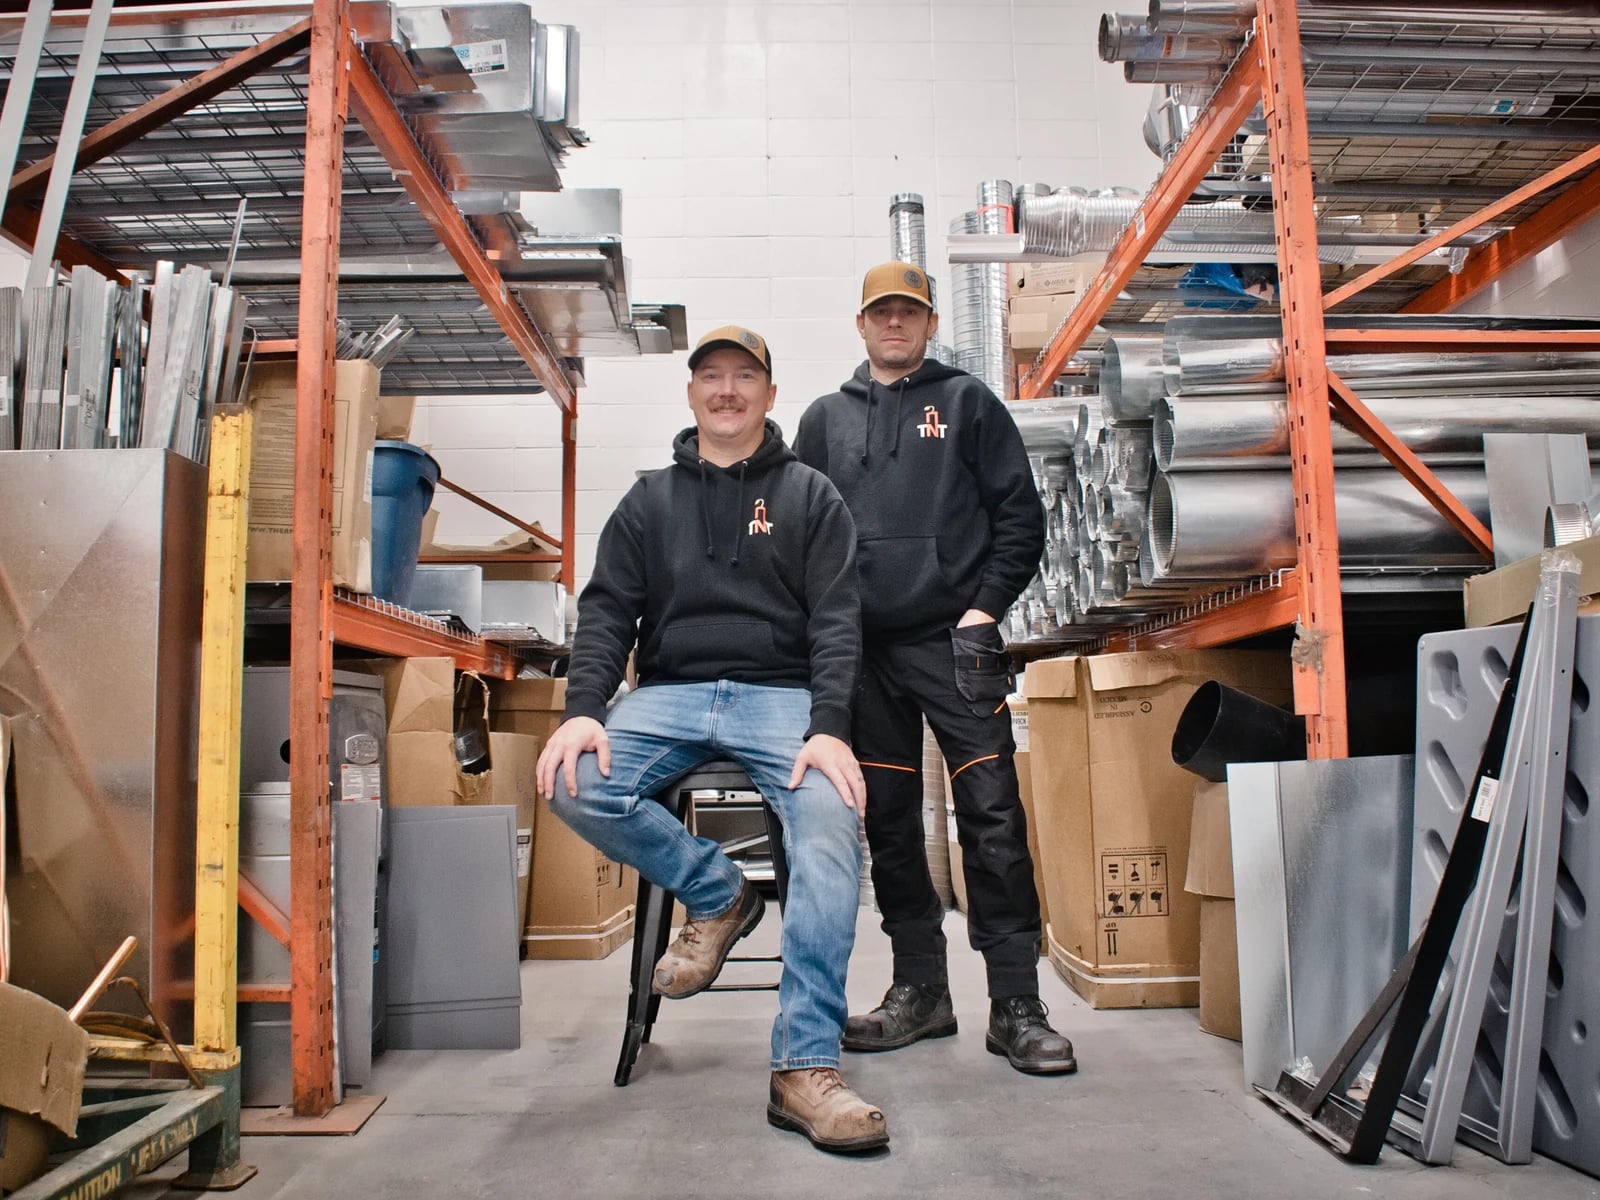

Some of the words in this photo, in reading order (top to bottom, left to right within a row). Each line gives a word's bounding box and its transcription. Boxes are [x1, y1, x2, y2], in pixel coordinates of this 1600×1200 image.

[916, 411, 948, 438] TNT
[748, 506, 774, 536] TNT
[1110, 703, 1118, 711] IN
